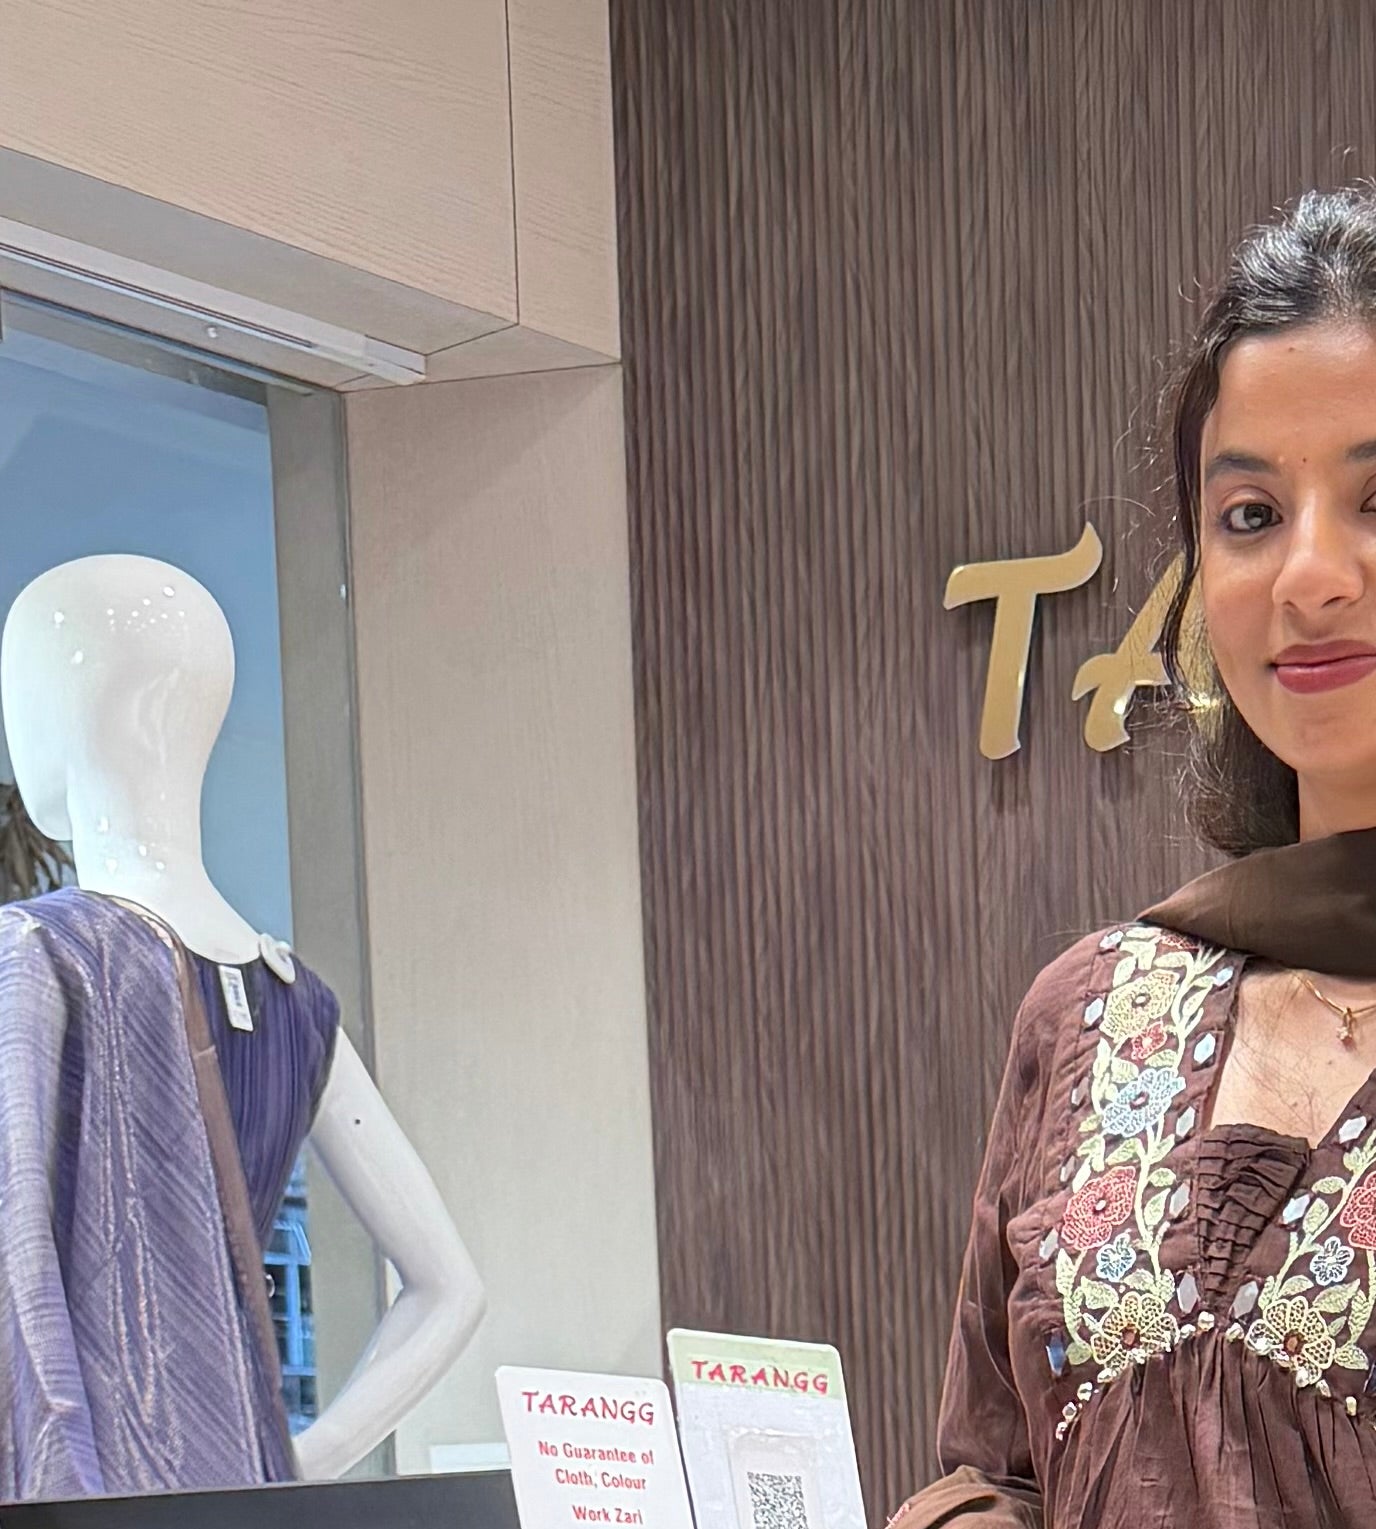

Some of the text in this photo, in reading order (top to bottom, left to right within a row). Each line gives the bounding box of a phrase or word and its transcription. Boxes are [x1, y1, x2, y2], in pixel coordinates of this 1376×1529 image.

[691, 1360, 828, 1395] TARANGG
[521, 1390, 654, 1426] TARANGG
[538, 1440, 655, 1465] No Guarantee of
[555, 1468, 647, 1490] Cloth, Colour
[572, 1504, 643, 1525] Work Zari
